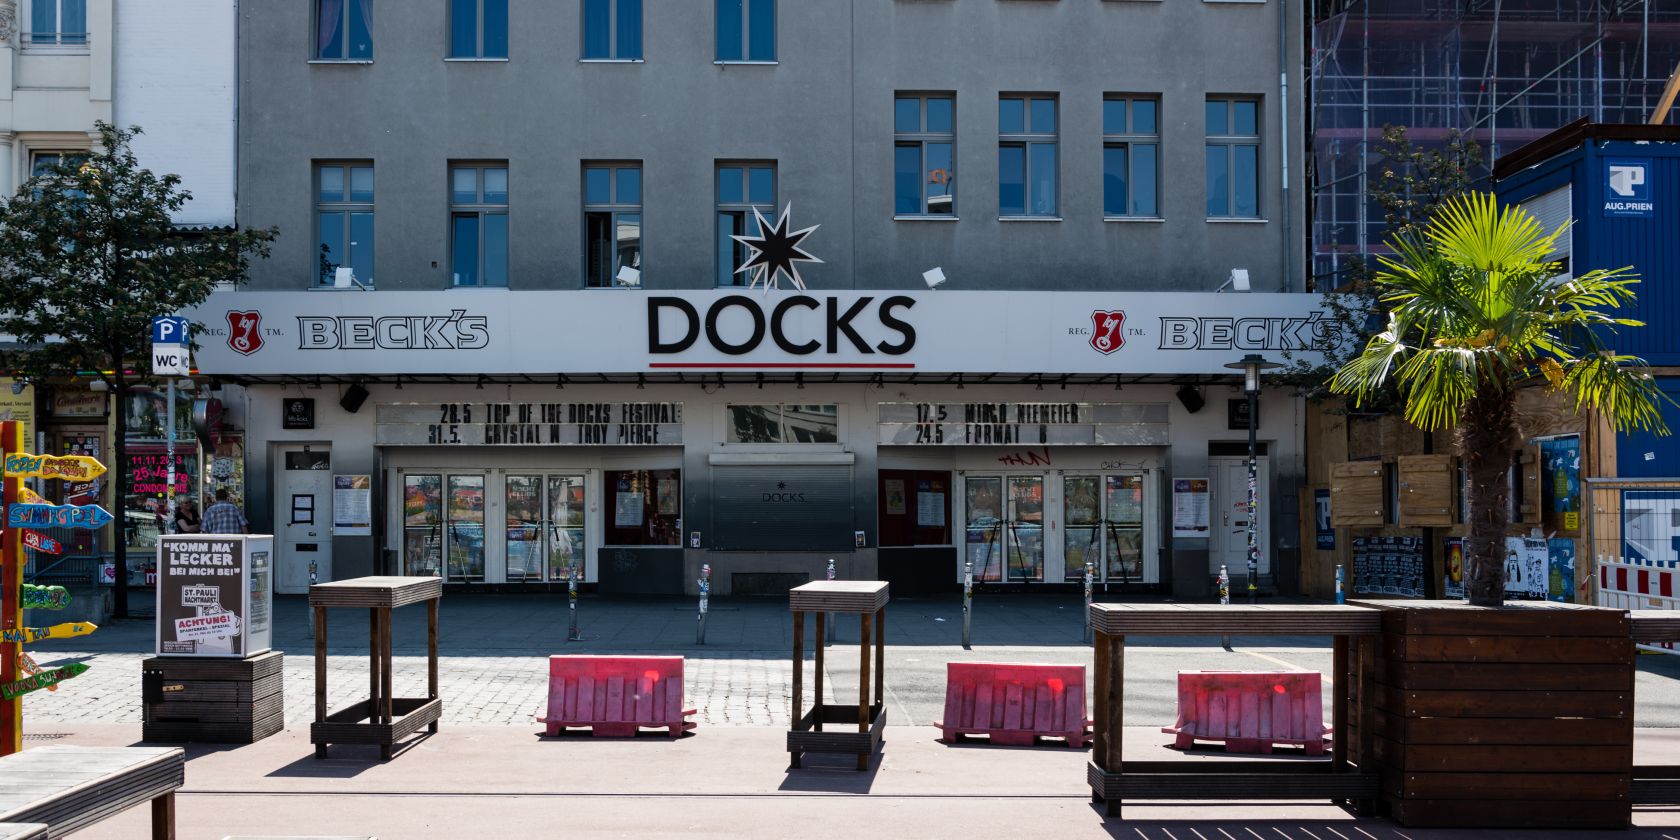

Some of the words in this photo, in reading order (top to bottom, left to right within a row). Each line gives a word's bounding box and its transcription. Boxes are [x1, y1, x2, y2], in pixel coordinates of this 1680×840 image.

[1604, 202, 1653, 211] AUG.PRIEN
[160, 322, 174, 341] P
[265, 328, 284, 336] TM.
[296, 309, 490, 350] BECK'S
[648, 295, 917, 355] DOCKS
[1128, 328, 1146, 336] TM.
[1157, 311, 1343, 350] BECK'S
[156, 355, 178, 367] WC
[181, 355, 189, 368] WC
[440, 403, 471, 423] 28.5
[487, 403, 510, 423] TOP
[519, 403, 533, 423] OF
[541, 403, 562, 423] THE
[569, 403, 610, 423] DOCKS
[1017, 403, 1079, 423] NIEMEIER
[428, 424, 461, 444] 31.5.
[485, 424, 540, 444] CRYSTAL
[578, 424, 608, 444] TROY
[618, 424, 659, 444] PIERCE
[916, 424, 943, 444] 24.5
[966, 424, 1019, 444] FORMAT
[133, 465, 150, 481] 25
[152, 465, 189, 483] Jare
[133, 483, 189, 493] CONDOMRIE
[71, 508, 99, 525] POOL
[170, 553, 233, 565] LECKER
[169, 567, 186, 575] BEI
[188, 567, 215, 575] MICH
[178, 615, 231, 628] ACHTUNG!
[3, 630, 27, 643] MAI
[29, 627, 50, 641] TAI
